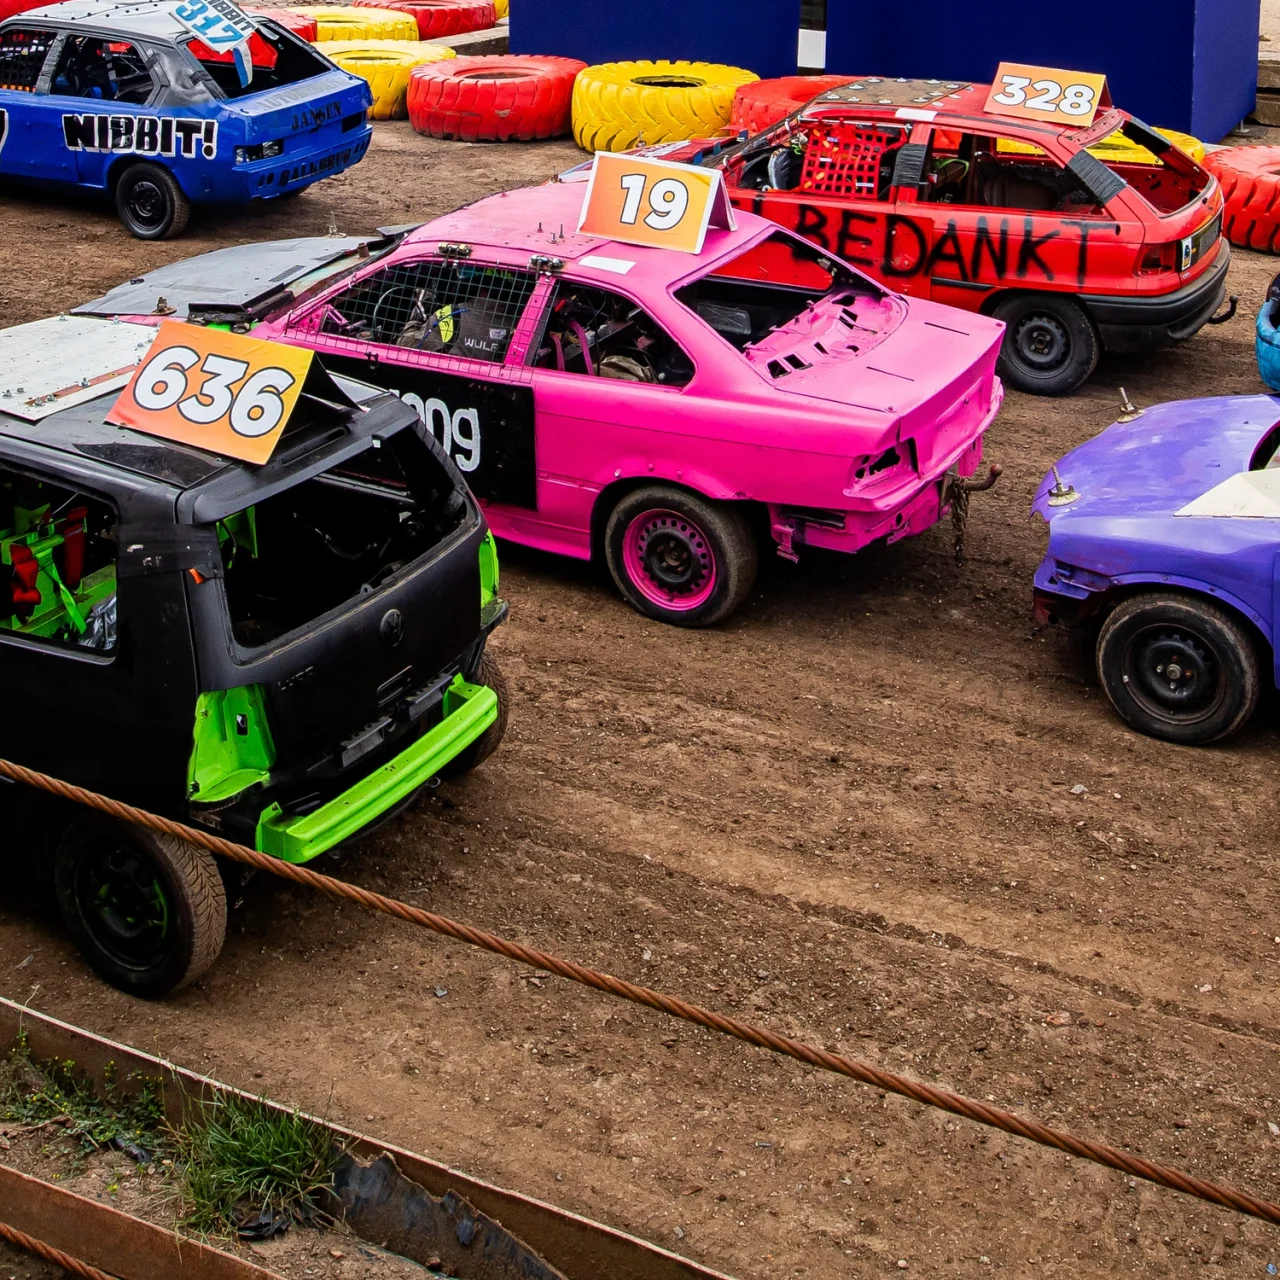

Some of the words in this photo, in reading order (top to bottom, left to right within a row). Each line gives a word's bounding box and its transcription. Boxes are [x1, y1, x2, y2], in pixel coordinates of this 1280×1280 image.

[992, 75, 1095, 116] 328
[62, 113, 218, 160] NIBBIT!
[620, 173, 690, 231] 19
[464, 337, 499, 352] WULF
[132, 344, 297, 439] 636
